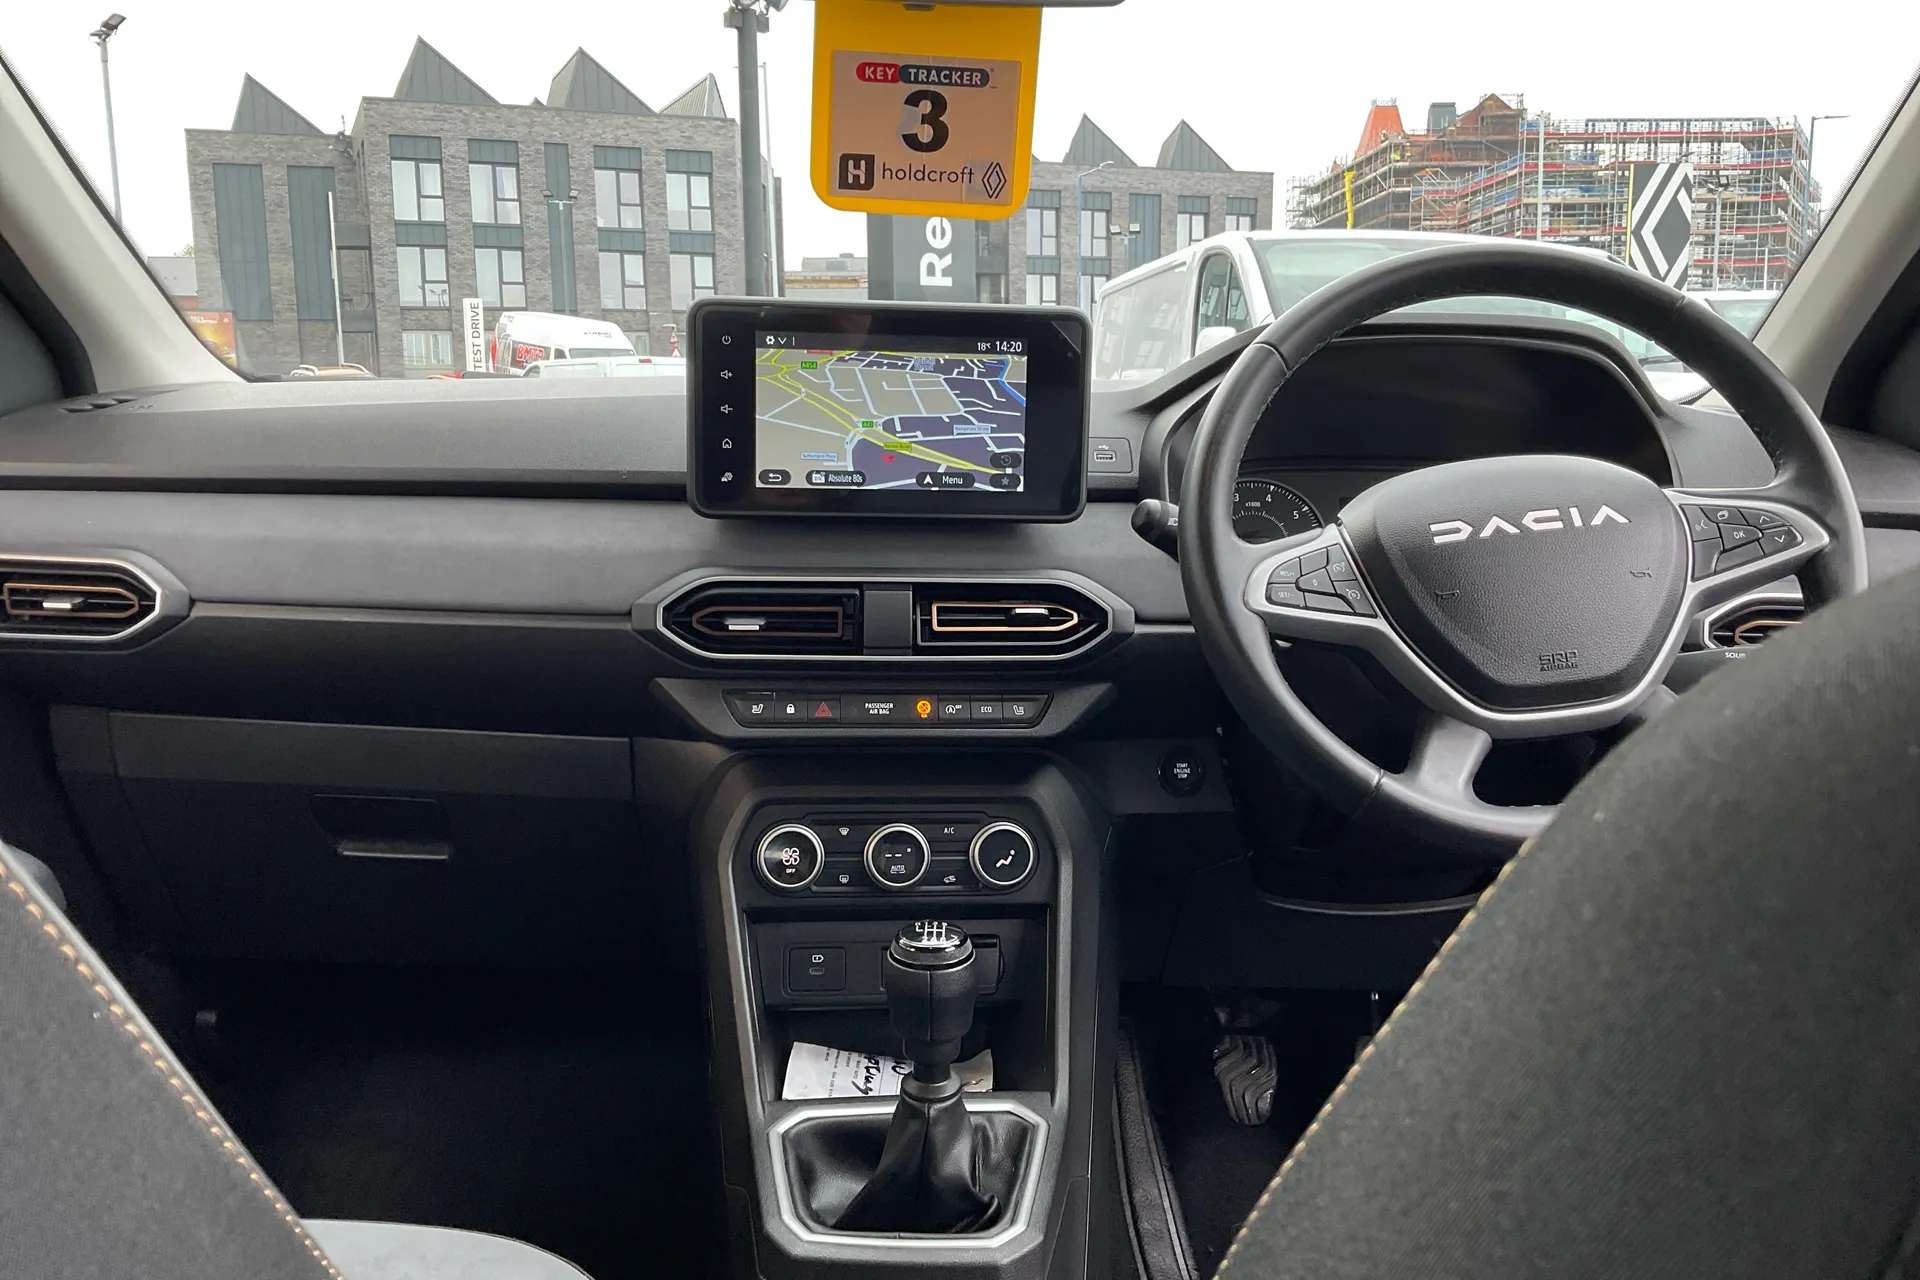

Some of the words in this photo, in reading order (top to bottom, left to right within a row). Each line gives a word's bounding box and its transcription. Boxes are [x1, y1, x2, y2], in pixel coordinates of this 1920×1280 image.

[864, 66, 896, 81] KEY
[908, 68, 982, 86] TRACKER
[901, 89, 950, 153] 3
[881, 162, 975, 185] holdcroft
[469, 302, 481, 339] DRIVE
[995, 341, 1023, 352] 14:20
[471, 342, 483, 372] TEST
[827, 473, 853, 483] Absolute
[852, 474, 863, 483] 80s
[942, 476, 963, 485] Menu
[1265, 493, 1272, 502] 4
[1293, 511, 1300, 520] 5
[1429, 504, 1632, 544] DACIA
[1733, 531, 1746, 540] OK
[943, 826, 956, 835] A/C
